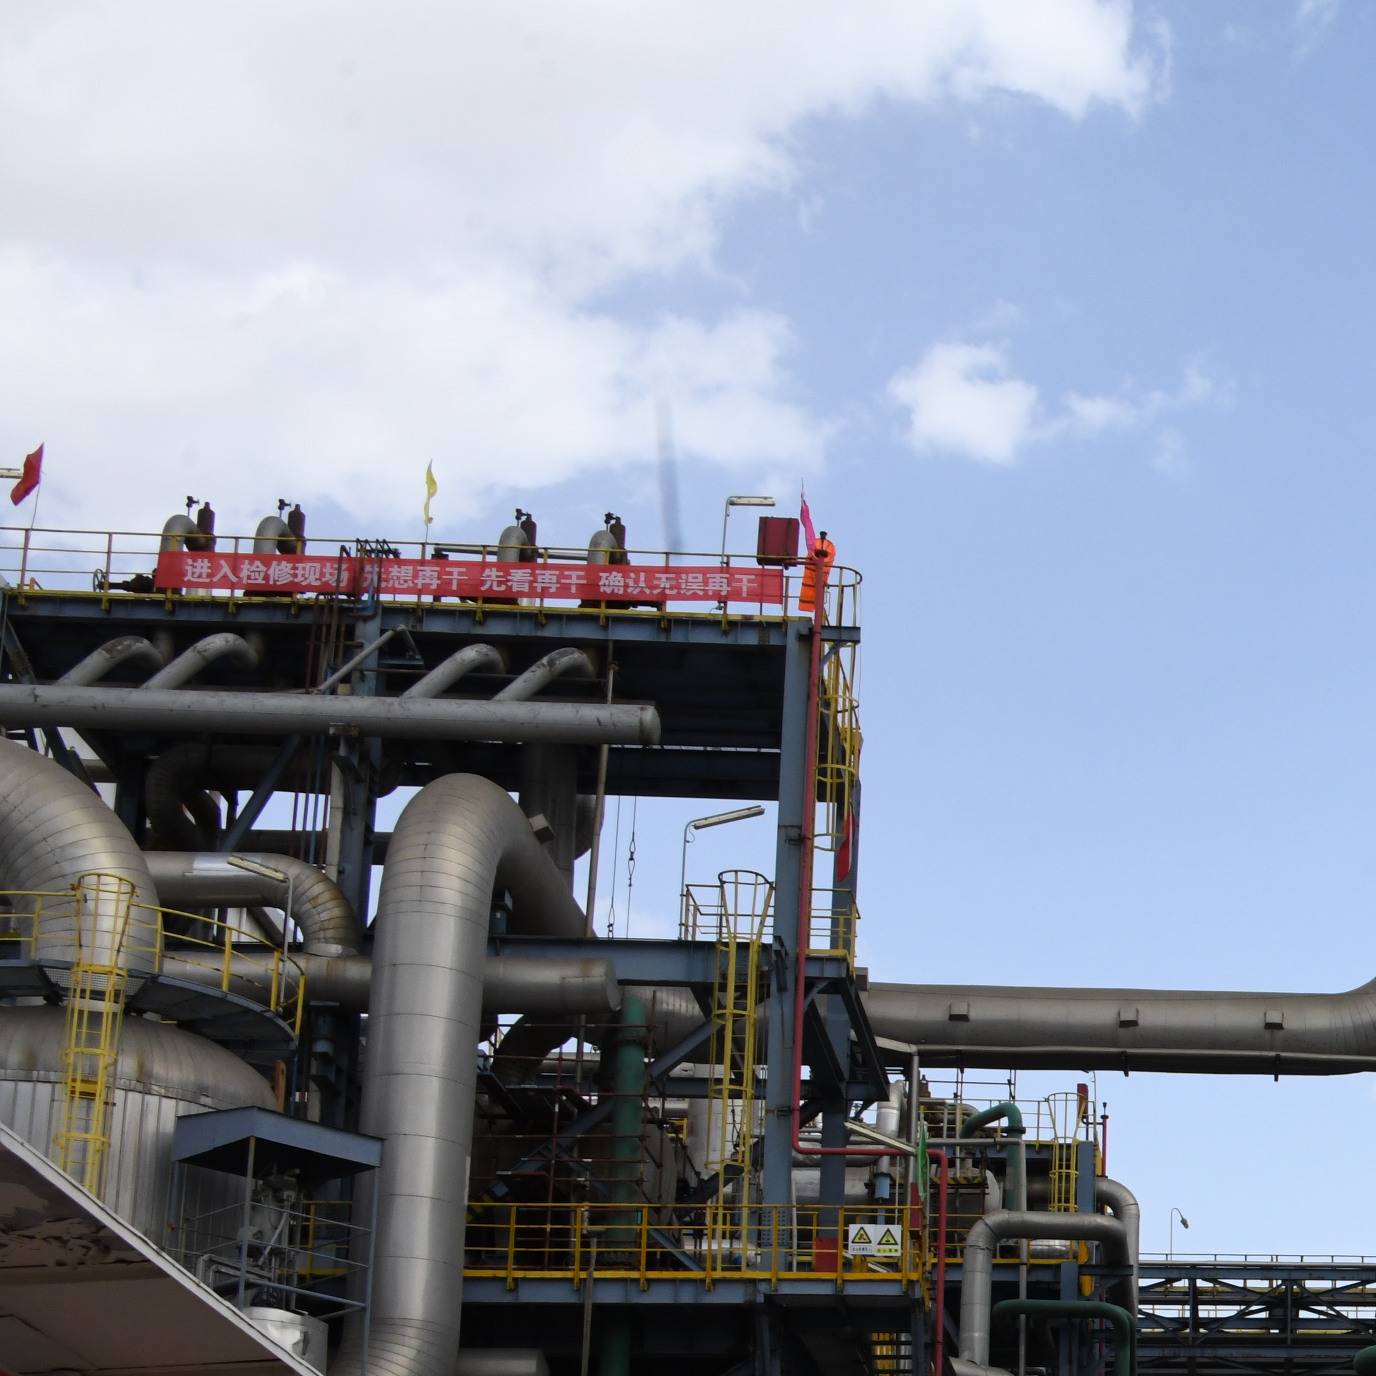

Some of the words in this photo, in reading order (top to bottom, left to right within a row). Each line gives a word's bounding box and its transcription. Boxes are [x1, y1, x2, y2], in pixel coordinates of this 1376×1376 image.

[183, 558, 349, 586] 进入检修现场
[480, 568, 587, 593] 先看再干
[599, 571, 757, 597] 确认无误再干
